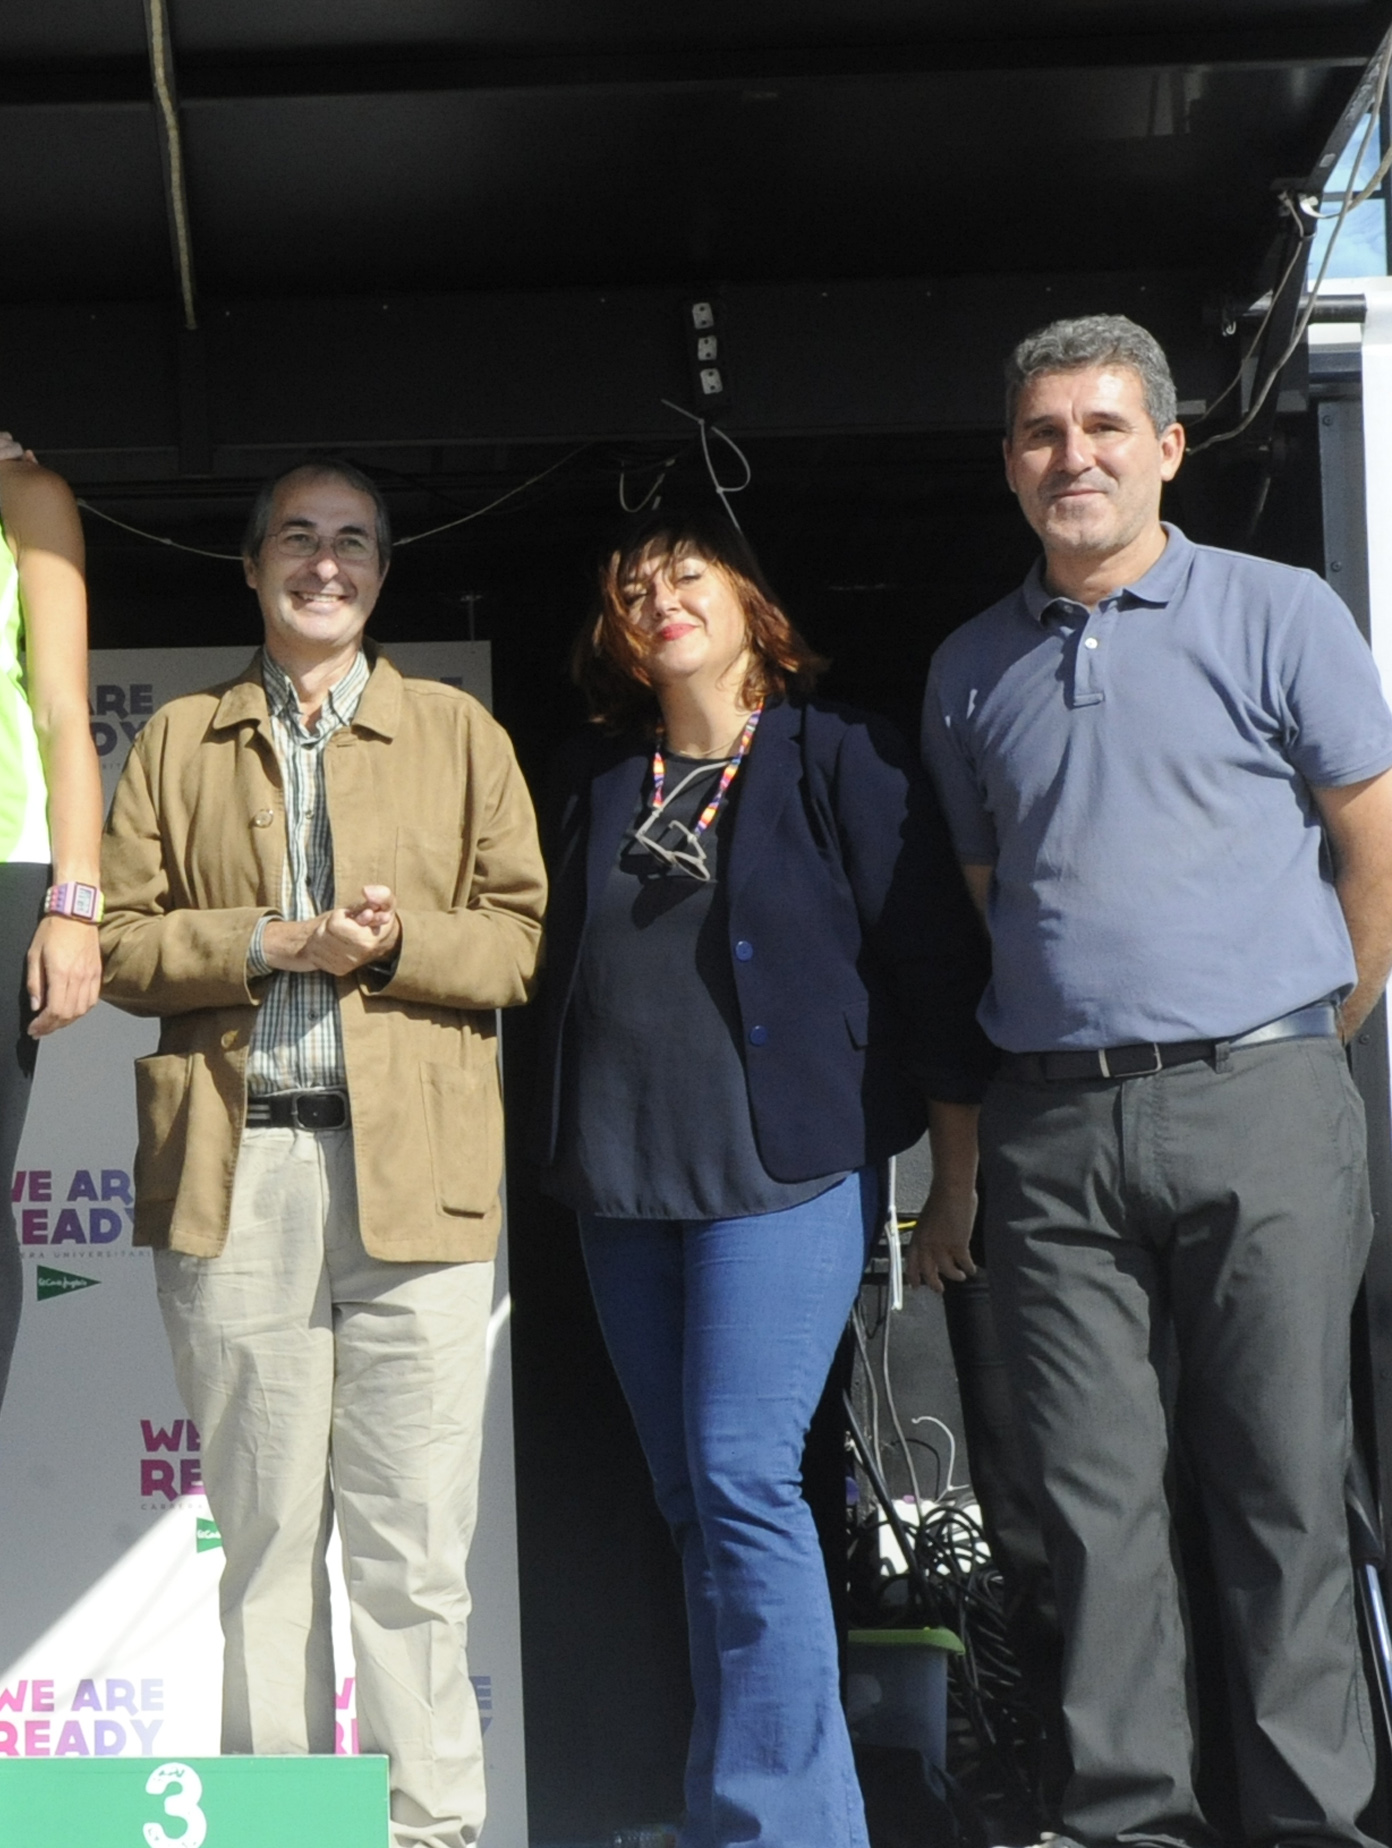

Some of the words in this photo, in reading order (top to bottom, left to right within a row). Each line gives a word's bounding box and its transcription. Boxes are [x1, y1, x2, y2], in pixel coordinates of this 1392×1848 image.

[88, 684, 154, 719] RE
[67, 1169, 134, 1206] AR
[22, 1207, 135, 1245] EAD
[54, 1250, 153, 1259] UNIVERSITARI
[71, 1678, 165, 1717] ARE
[142, 1762, 208, 1848] 3
